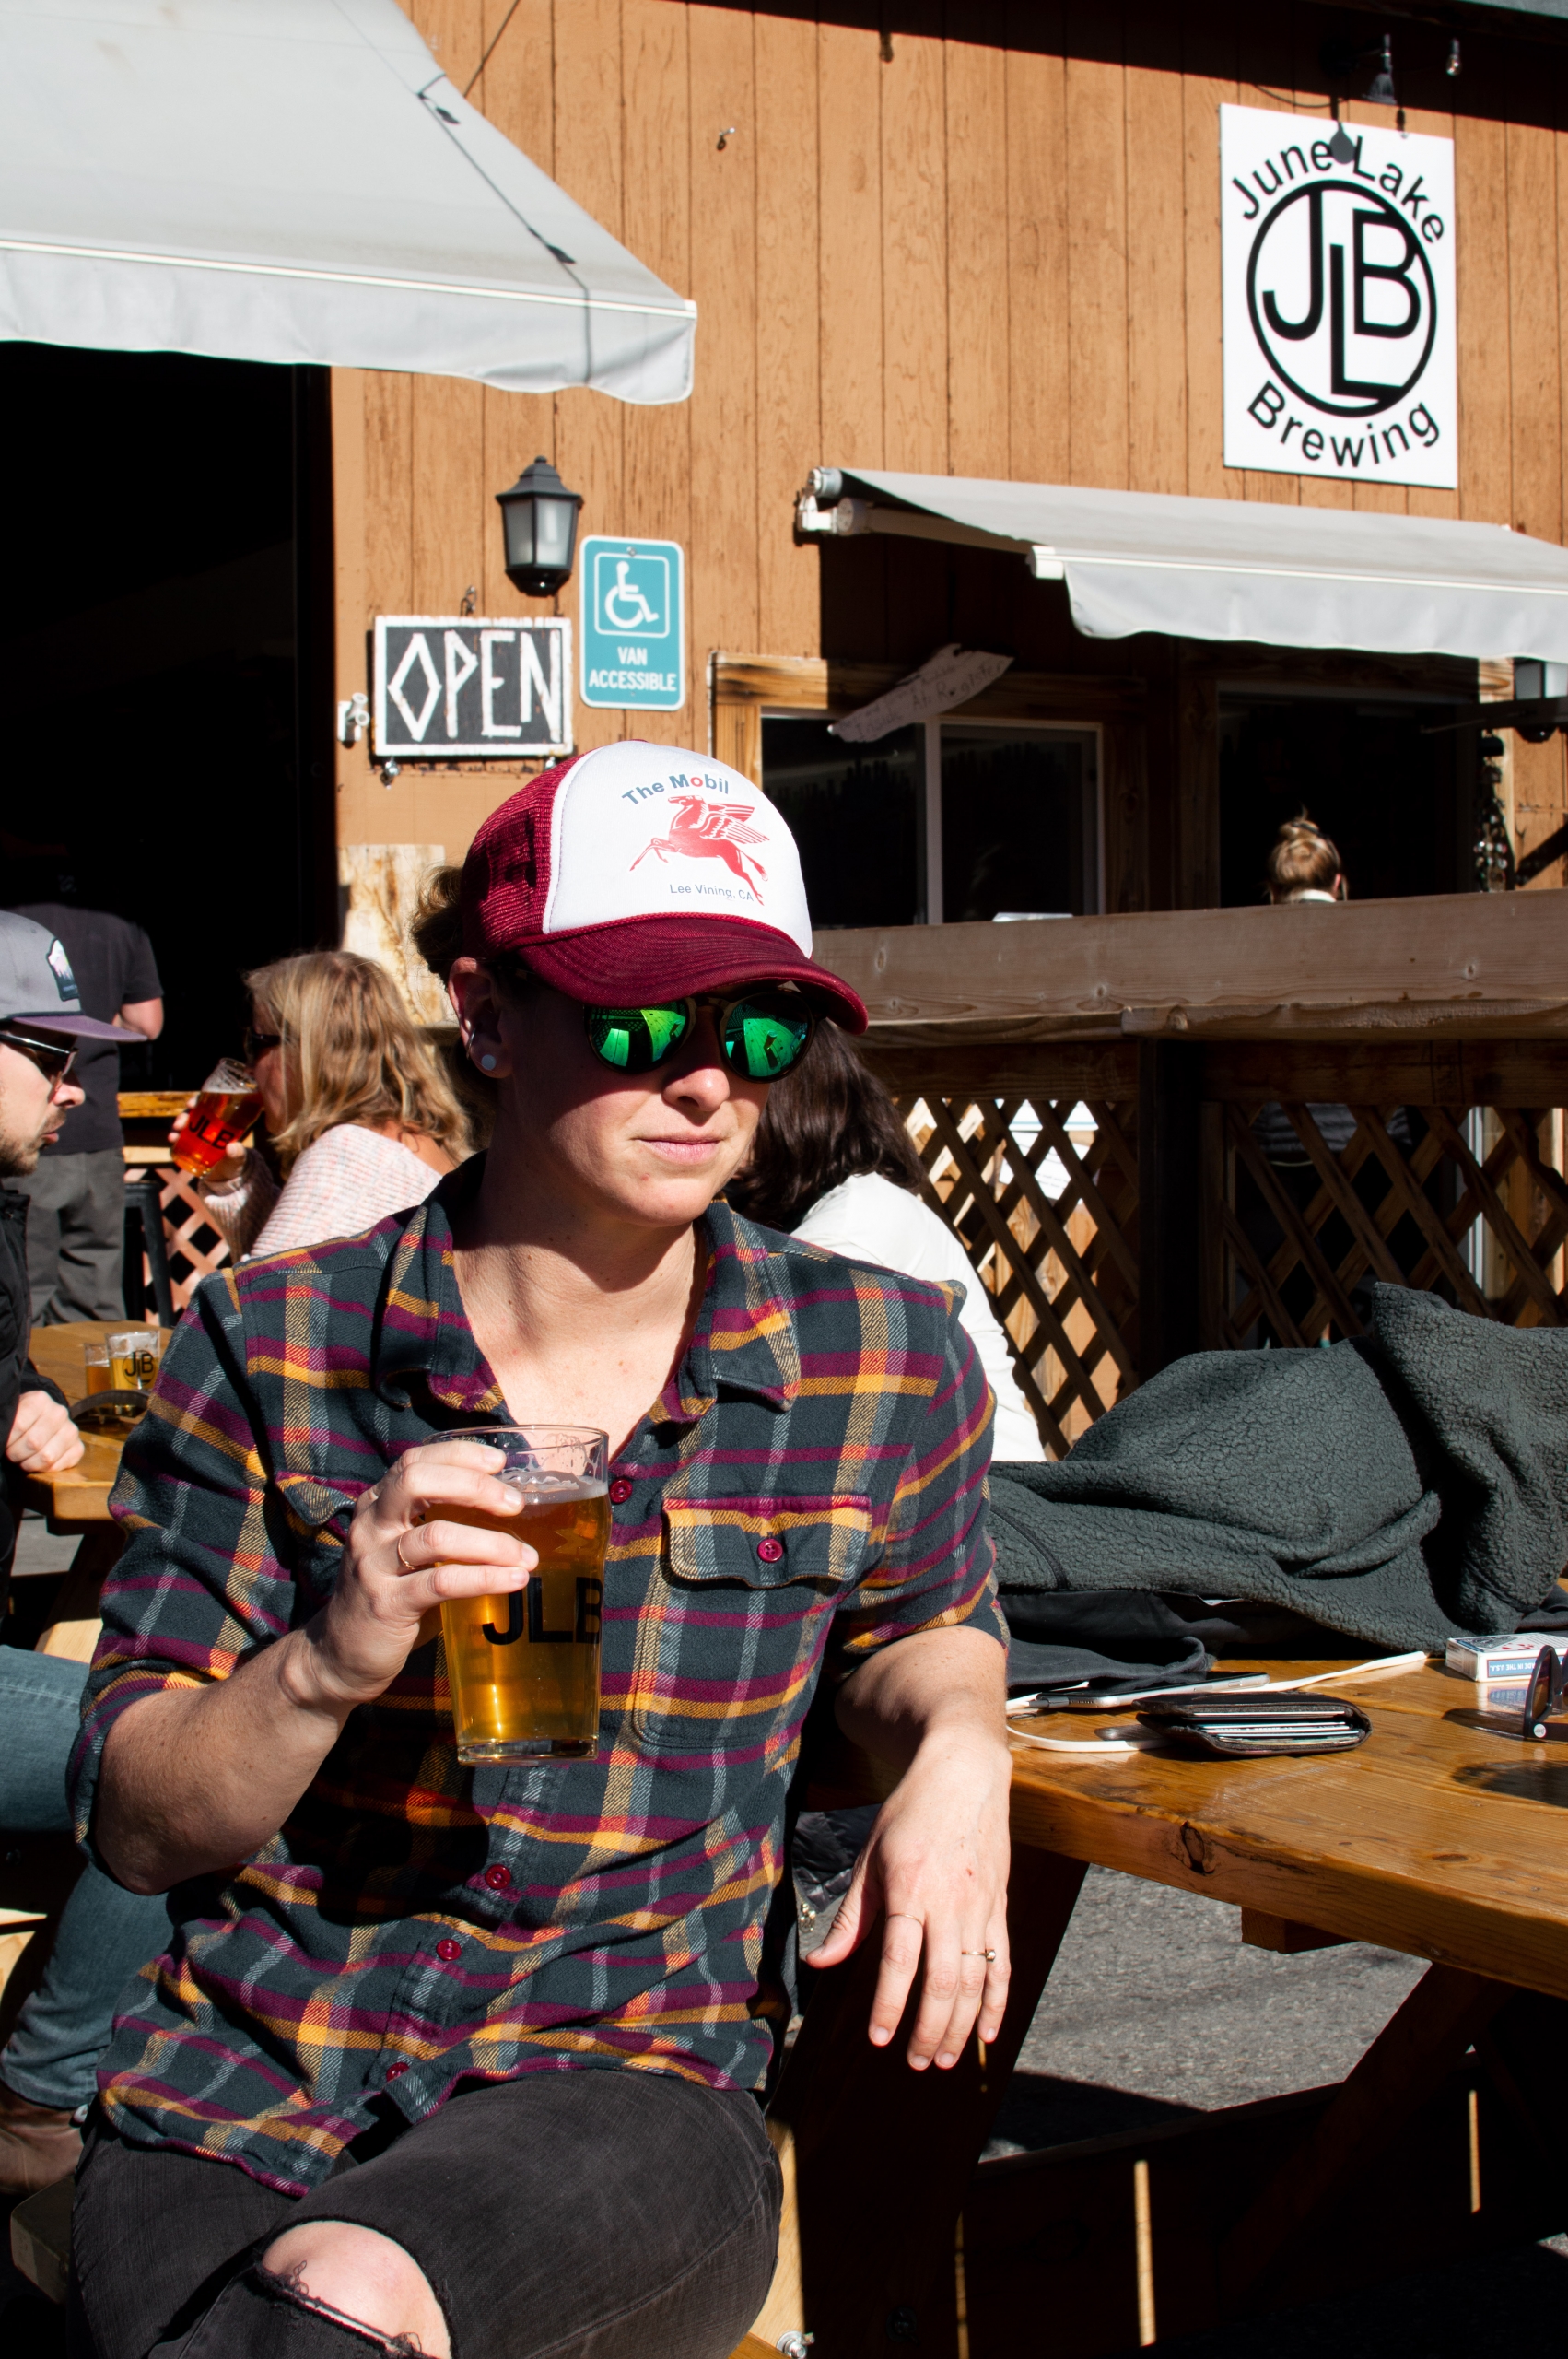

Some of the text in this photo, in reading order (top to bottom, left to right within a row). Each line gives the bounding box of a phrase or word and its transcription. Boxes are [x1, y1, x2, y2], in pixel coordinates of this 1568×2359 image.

[1232, 135, 1445, 243] June Lake
[1261, 184, 1422, 403] JLB
[1246, 380, 1440, 468] Brewing
[617, 646, 648, 666] VAN
[387, 629, 561, 744] OPEN
[588, 669, 677, 692] ACCESSIBLE
[621, 773, 729, 804] The Mobil
[669, 884, 755, 901] Lee Vining, CA
[188, 1115, 235, 1150] JLB
[482, 1577, 603, 1646] JLB
[1505, 1663, 1517, 1672] THE
